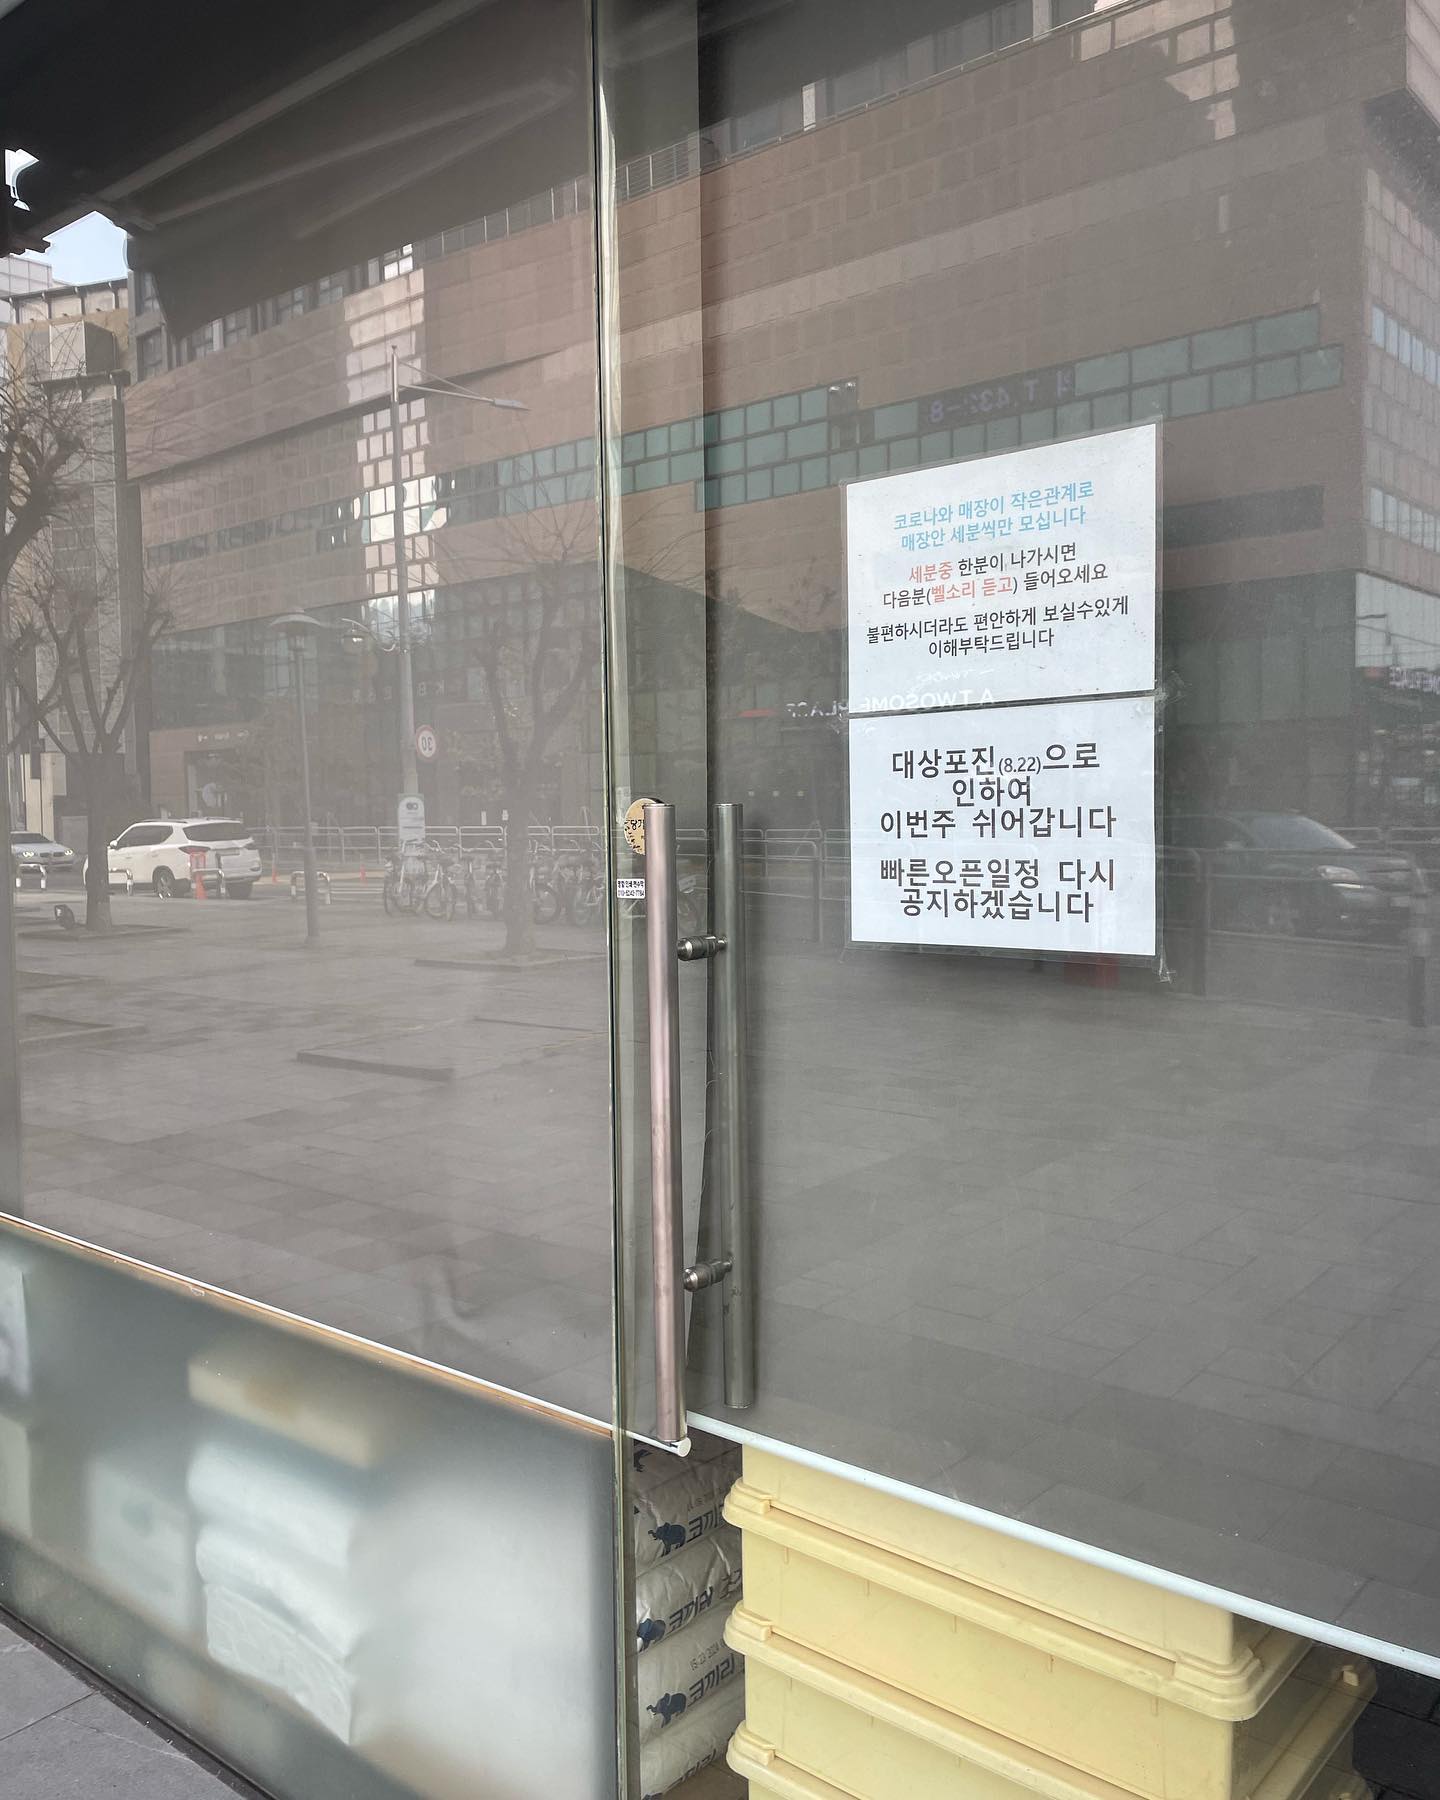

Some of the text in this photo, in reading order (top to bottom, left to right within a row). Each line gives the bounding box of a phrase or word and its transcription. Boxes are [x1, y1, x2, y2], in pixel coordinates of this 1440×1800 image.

[894, 480, 1094, 530] 코로나와 매장이 작은관계로
[901, 505, 1086, 552] 매장안 세분씩만 모십니다
[908, 542, 1077, 582] 세분중 한분이 나가시면
[883, 562, 1109, 610] 다음분(벨소리 듣고) 들어오세요
[866, 595, 1129, 644] 불편하시더라도 편안하게 보실수있게
[928, 627, 1055, 659] 이해부탁드립니다
[892, 742, 1101, 780] 대상포진(8.22)으로
[952, 775, 1032, 807] 인하여
[880, 805, 1117, 839] 이번주 쉬어갑니다
[880, 858, 1115, 891] 빠른오픈일정 다시
[900, 888, 1095, 923] 공지하겠습니다
[686, 1503, 725, 1543] 코끼
[688, 1653, 735, 1708] 코끼리
